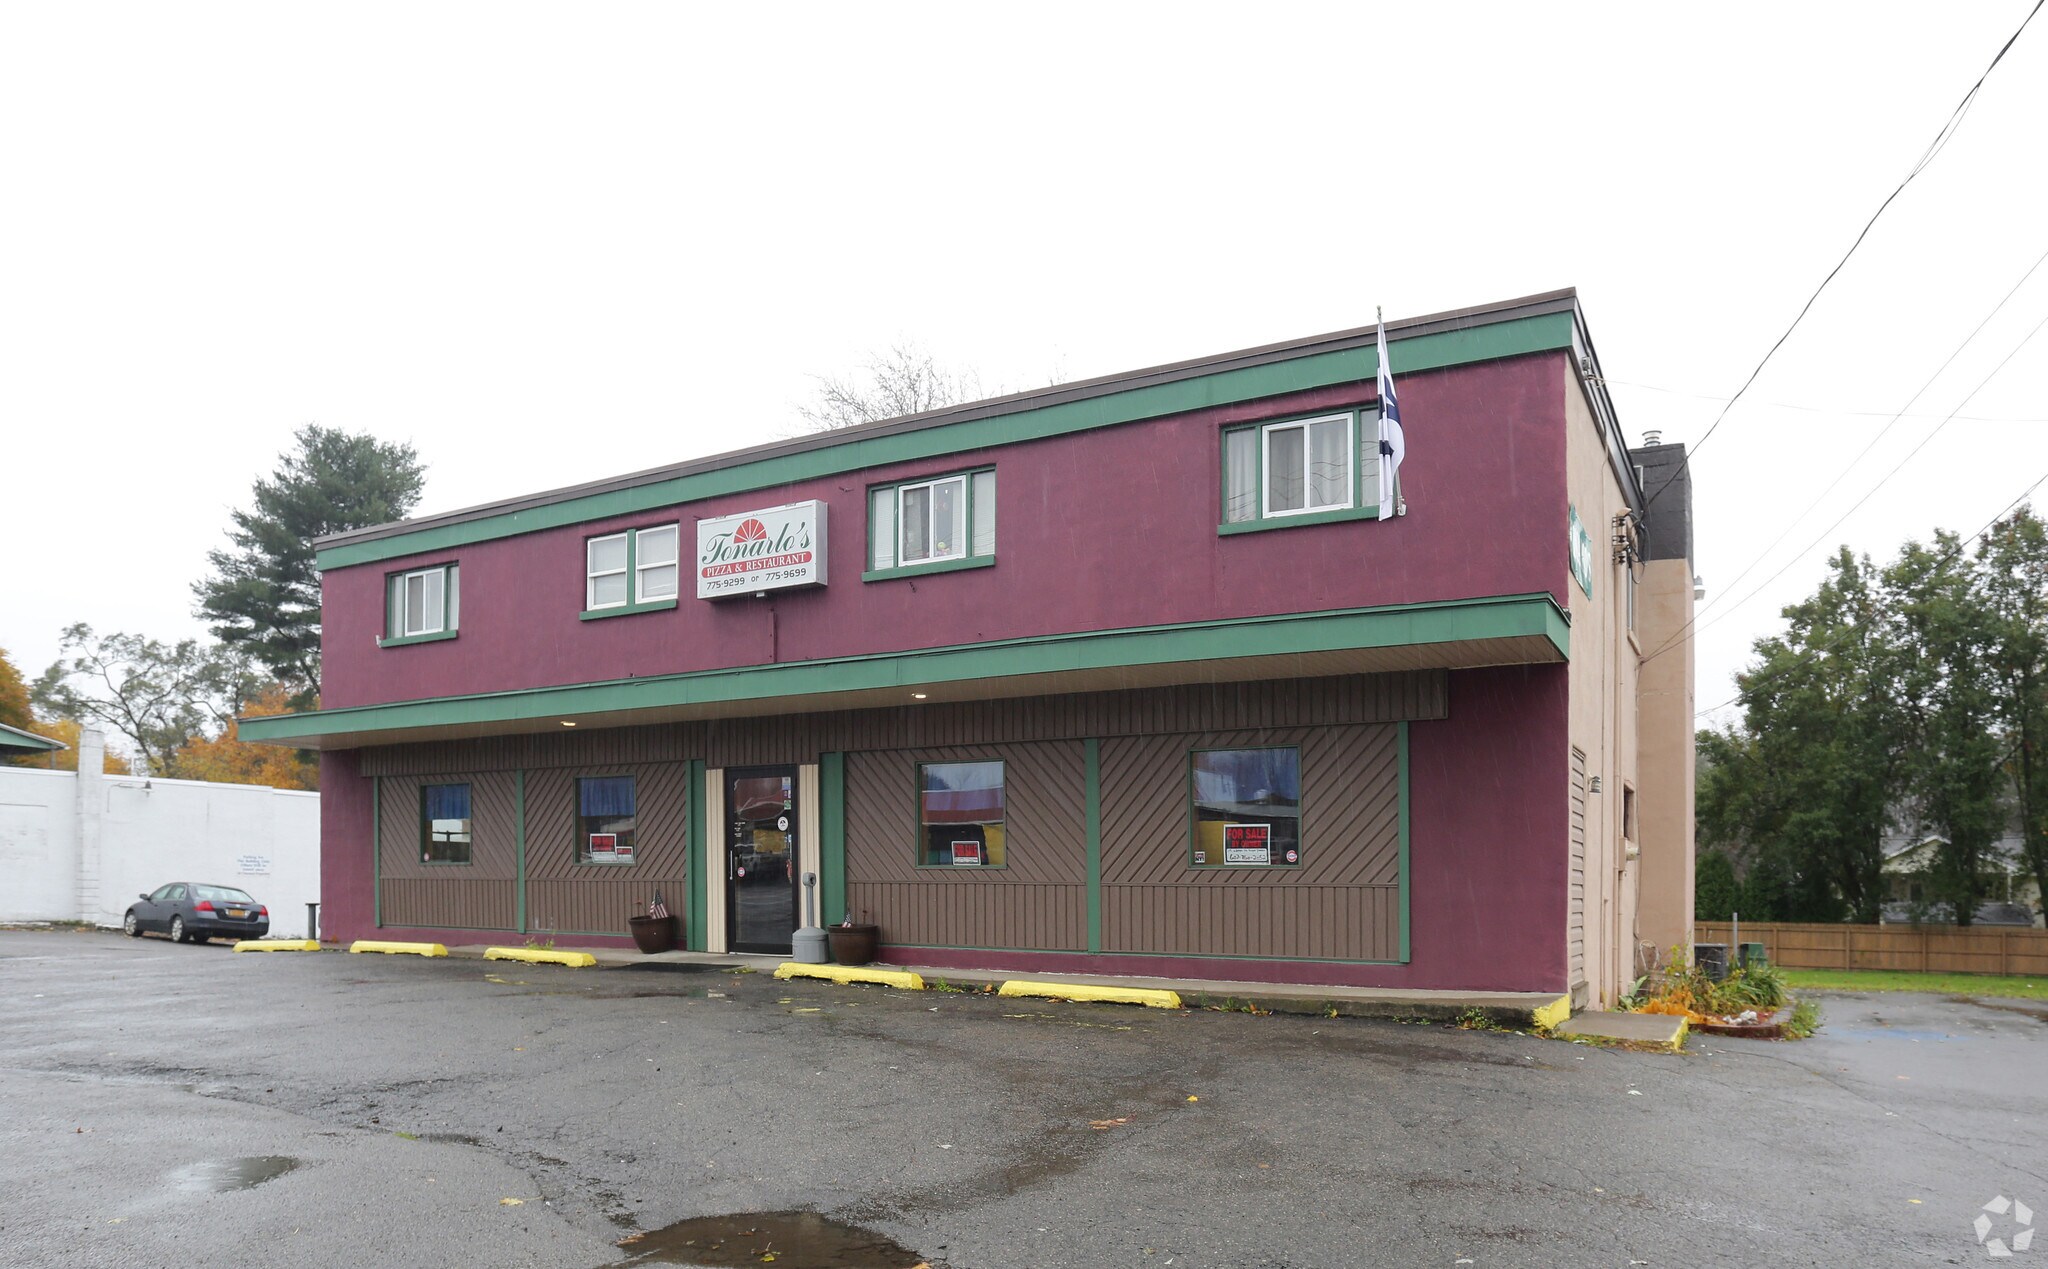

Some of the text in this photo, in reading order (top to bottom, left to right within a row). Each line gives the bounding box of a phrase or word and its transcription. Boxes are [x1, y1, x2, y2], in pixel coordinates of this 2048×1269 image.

[702, 521, 811, 565] Tonarlo's
[706, 552, 807, 577] PIZZA & RESTAURANT
[751, 575, 760, 583] or
[1227, 828, 1267, 839] FOR SALE
